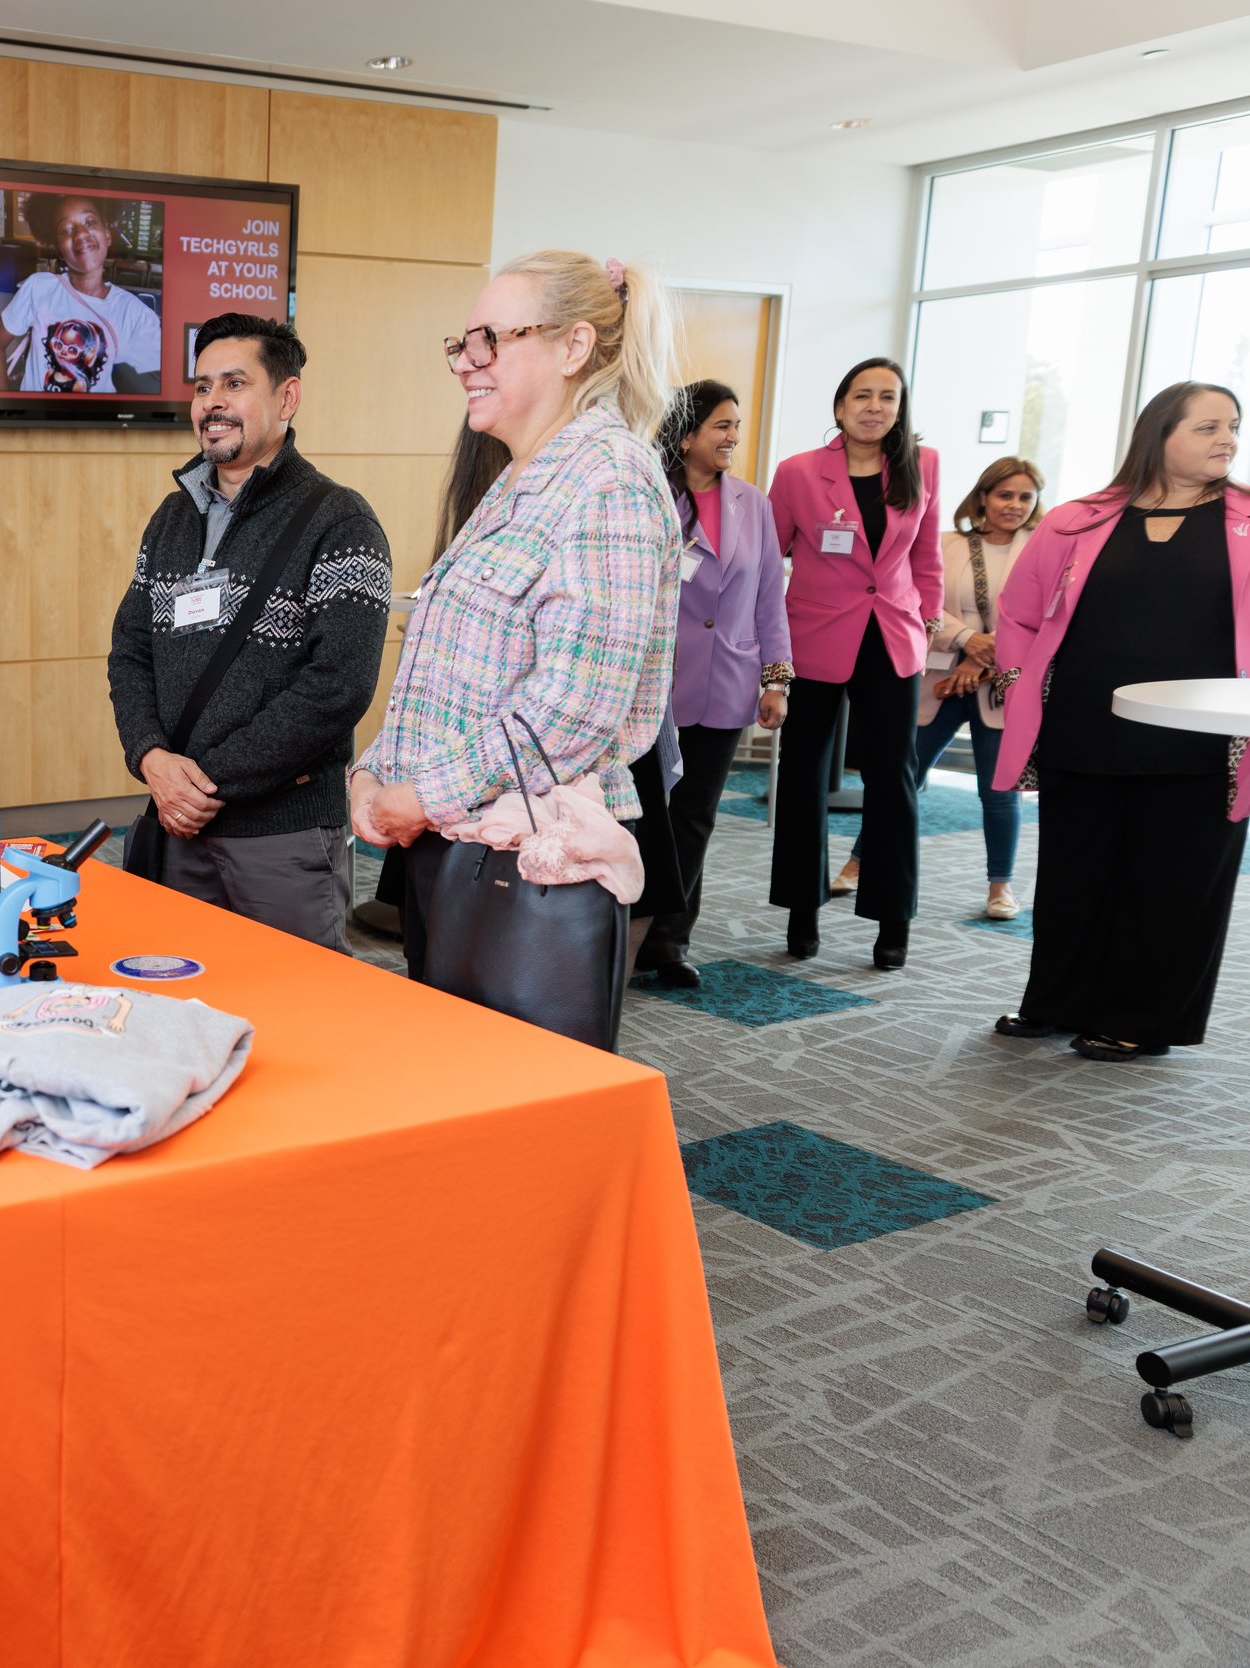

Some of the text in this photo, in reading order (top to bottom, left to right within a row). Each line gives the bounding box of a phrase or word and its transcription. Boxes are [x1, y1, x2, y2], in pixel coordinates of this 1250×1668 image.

[242, 219, 279, 236] JOIN
[179, 236, 279, 257] TECHGYRLS
[207, 261, 279, 279] AT YOUR
[209, 282, 278, 300] SCHOOL
